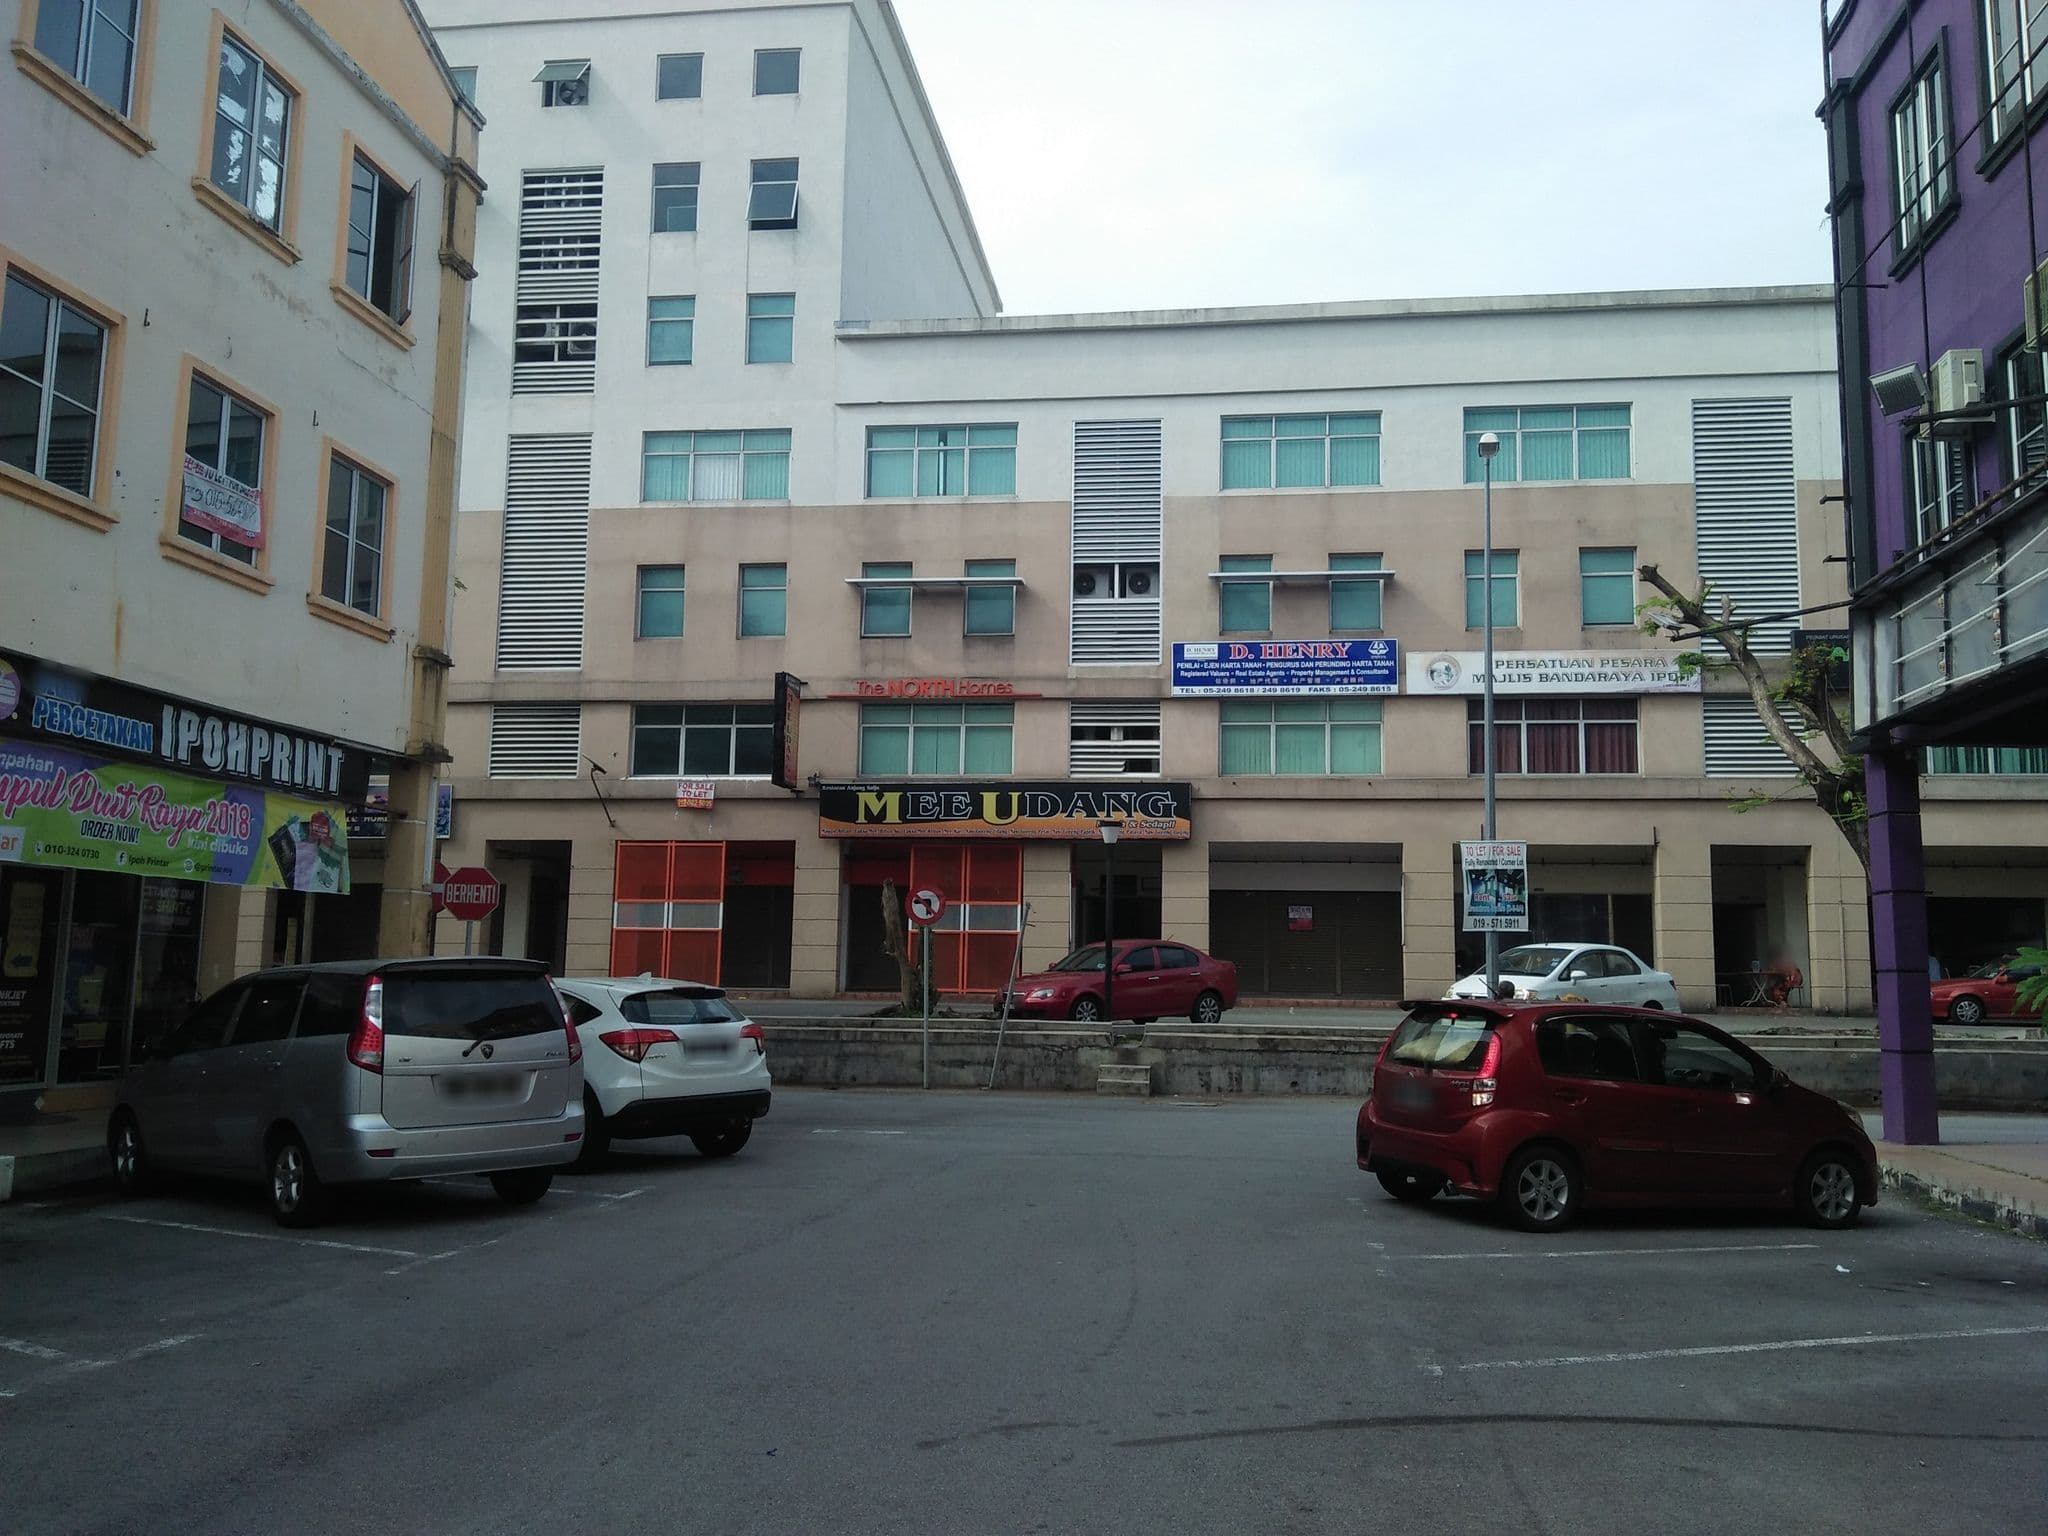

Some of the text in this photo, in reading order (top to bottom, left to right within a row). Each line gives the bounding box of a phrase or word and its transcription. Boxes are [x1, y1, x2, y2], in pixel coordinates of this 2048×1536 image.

[1229, 642, 1352, 660] D. HENRY
[1242, 661, 1262, 669] TANAH
[1352, 660, 1373, 668] HARTA
[1495, 658, 1667, 669] PERSATUAN PESARA
[1266, 670, 1285, 678] Agents
[1291, 669, 1314, 677] Property
[1539, 671, 1643, 682] BANDARAYA
[857, 679, 1013, 697] The NORTH Homes
[32, 695, 153, 753] PERCETAKAN
[678, 782, 714, 791] FOR SALE
[68, 769, 138, 820] Duit
[137, 783, 206, 848] Raya
[206, 799, 251, 840] 2018
[856, 791, 1177, 825] MEE UDANG
[80, 819, 140, 843] ORDER NOW!
[1128, 820, 1137, 829] &
[45, 844, 100, 860] 010-324 0730
[210, 836, 249, 857] dibuka
[1466, 846, 1473, 856] TO
[1476, 846, 1486, 856] LET
[1492, 846, 1504, 856] FOR
[1507, 846, 1520, 856] SALE
[129, 854, 145, 867] Ipoh
[446, 884, 495, 904] BERHENTI
[1473, 918, 1485, 928] 019
[1490, 918, 1503, 928] 571
[1504, 918, 1519, 928] 5911
